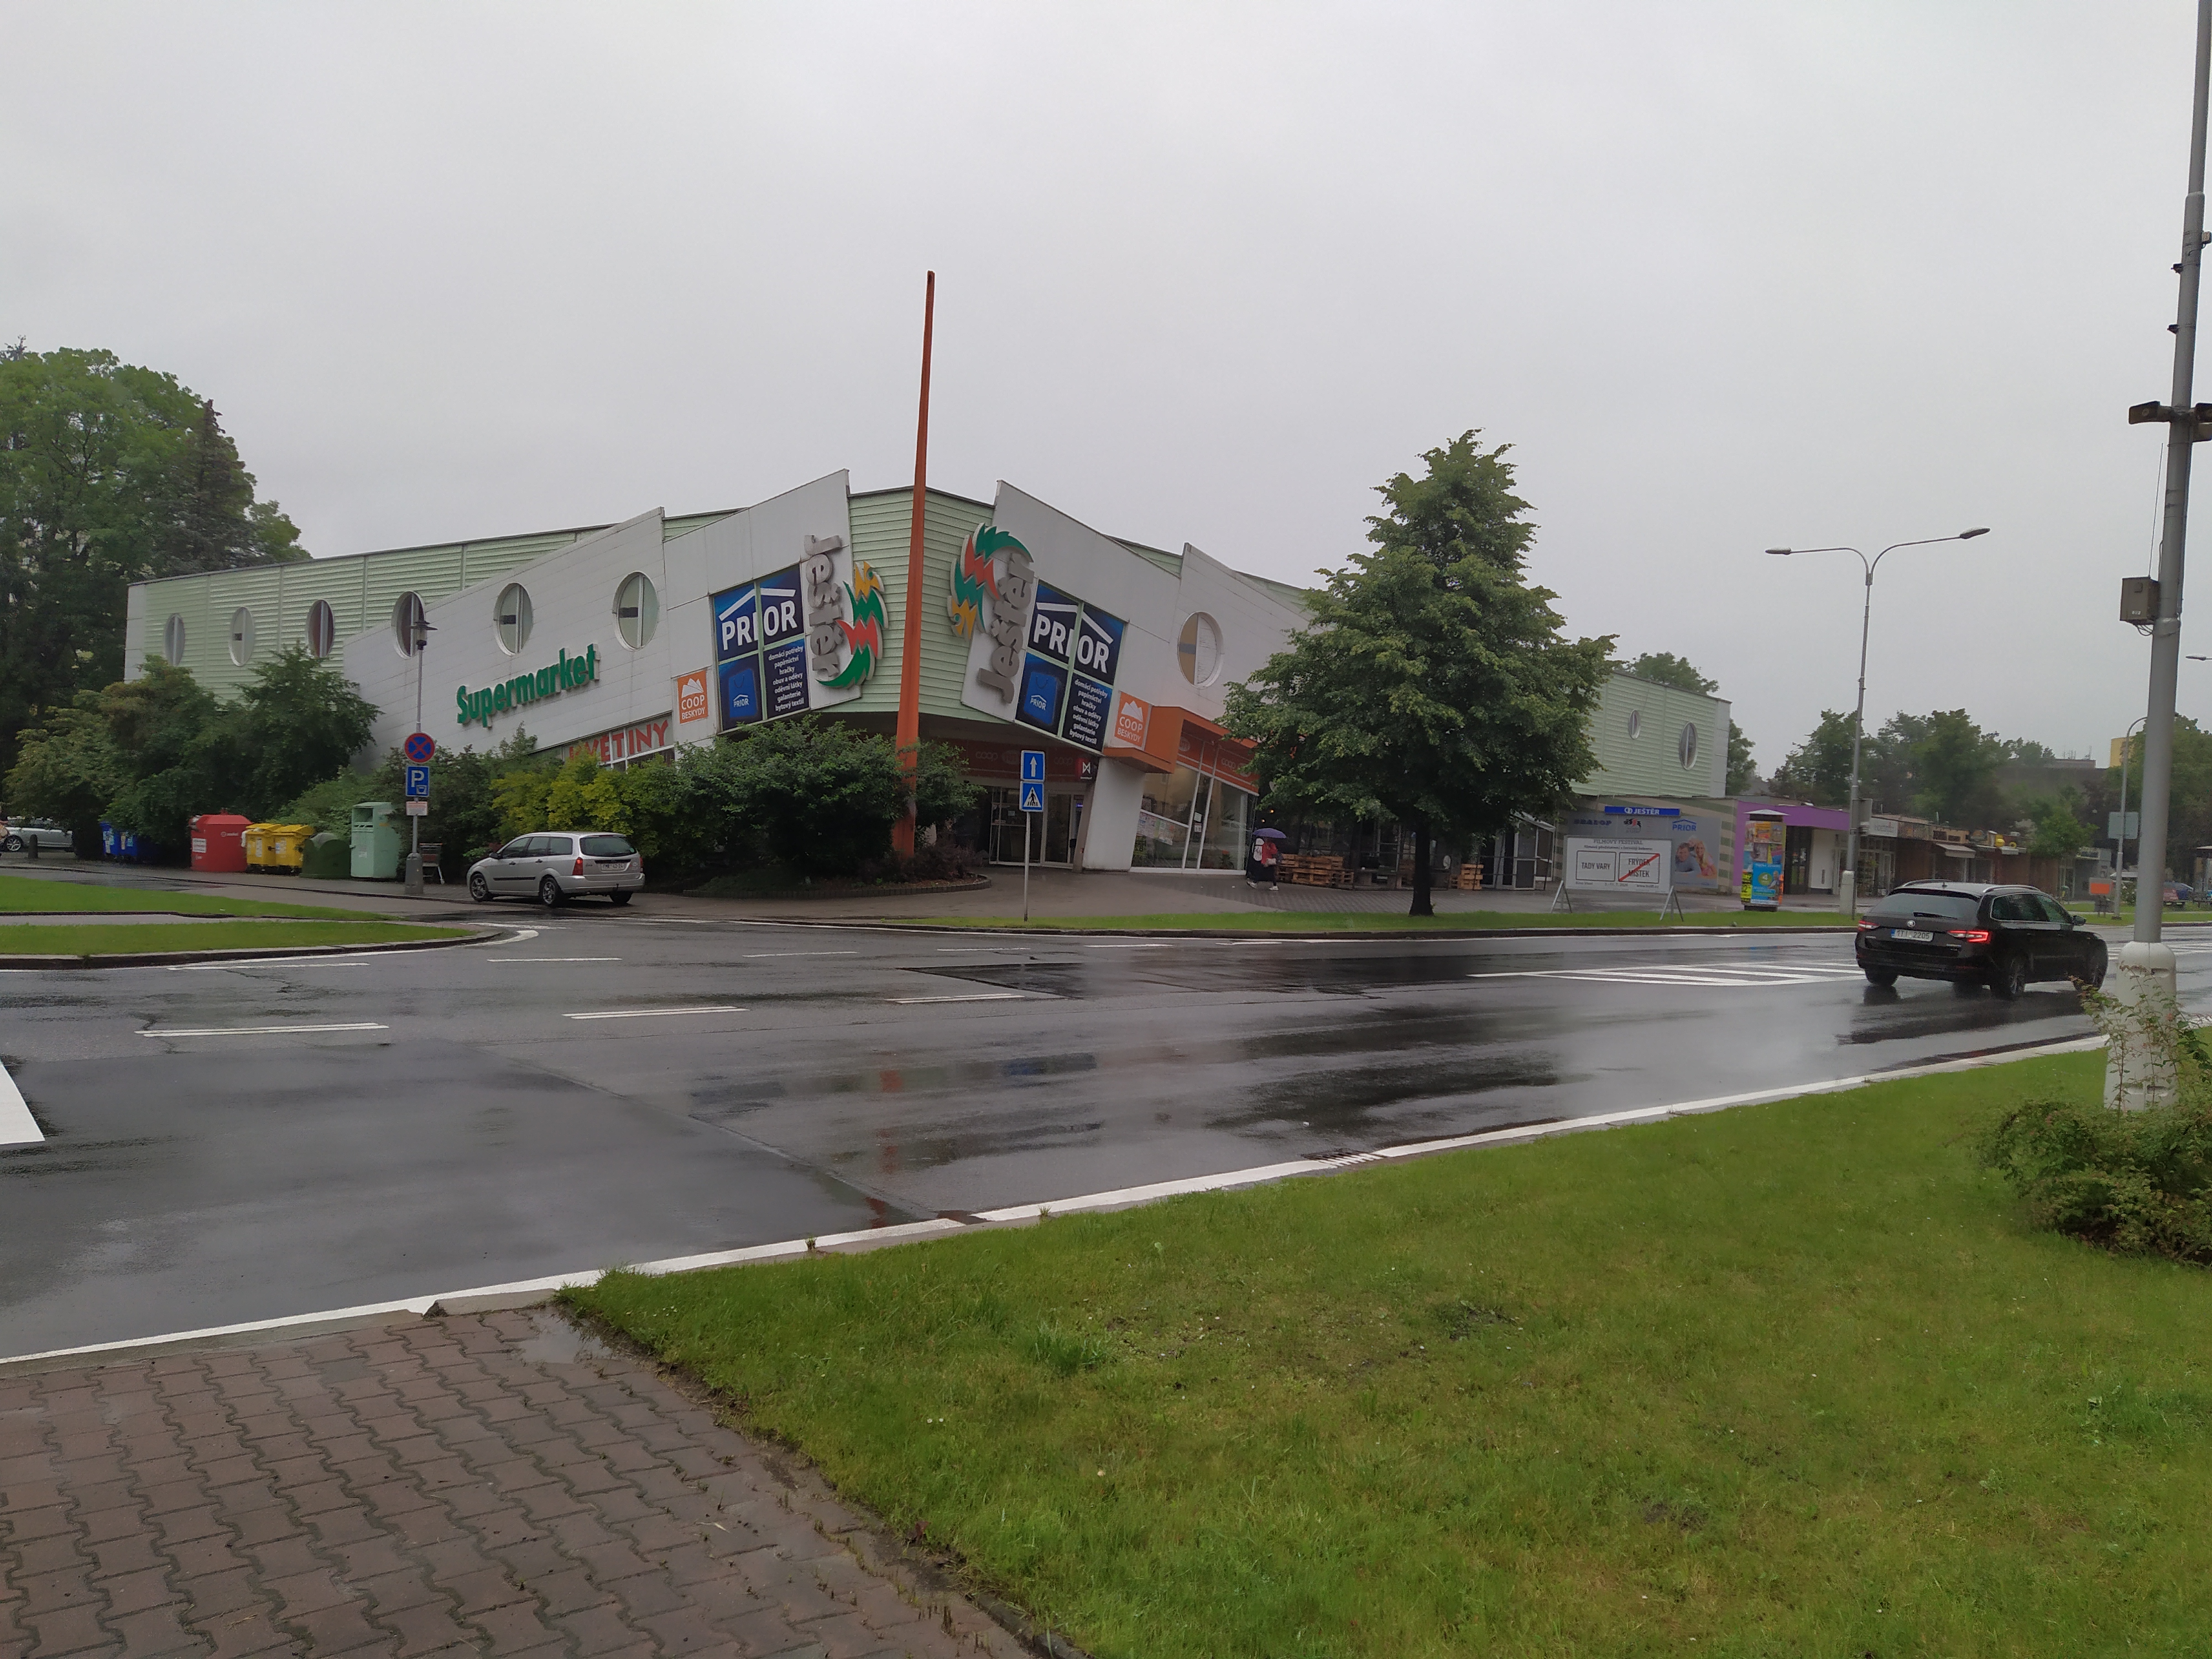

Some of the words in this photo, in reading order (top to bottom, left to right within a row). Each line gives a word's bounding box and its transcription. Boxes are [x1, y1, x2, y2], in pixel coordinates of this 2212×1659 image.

[722, 600, 797, 651] PRIOR
[1034, 613, 1109, 674] PRIOR
[768, 650, 785, 661] domácí
[785, 646, 804, 657] potřeby
[774, 655, 799, 669] papírnictví
[779, 666, 795, 675] hračky
[788, 672, 803, 681] oděvy
[457, 643, 599, 728] Supermarket
[774, 684, 790, 693] oděvní
[790, 681, 803, 689] látky
[1074, 679, 1091, 690] domácí
[1091, 686, 1108, 698] potřeby
[681, 695, 705, 710] COOP
[733, 698, 749, 707] PRIOR
[777, 690, 801, 703] galanterie
[1078, 690, 1102, 703] papírnictví
[775, 701, 791, 712] bytový
[791, 697, 804, 707] textil
[1030, 697, 1047, 711] PRIOR
[1081, 699, 1097, 711] hračky
[682, 707, 705, 719] BESKYDY
[1073, 705, 1084, 713] obuv
[1088, 711, 1102, 722] oděvy
[1073, 723, 1095, 735] galanterie
[1088, 718, 1099, 729] látky
[1119, 716, 1142, 733] COOP
[1069, 729, 1085, 741] bytový
[1085, 735, 1097, 744] textil
[1117, 727, 1141, 742] BESKYDY
[411, 770, 424, 787] P
